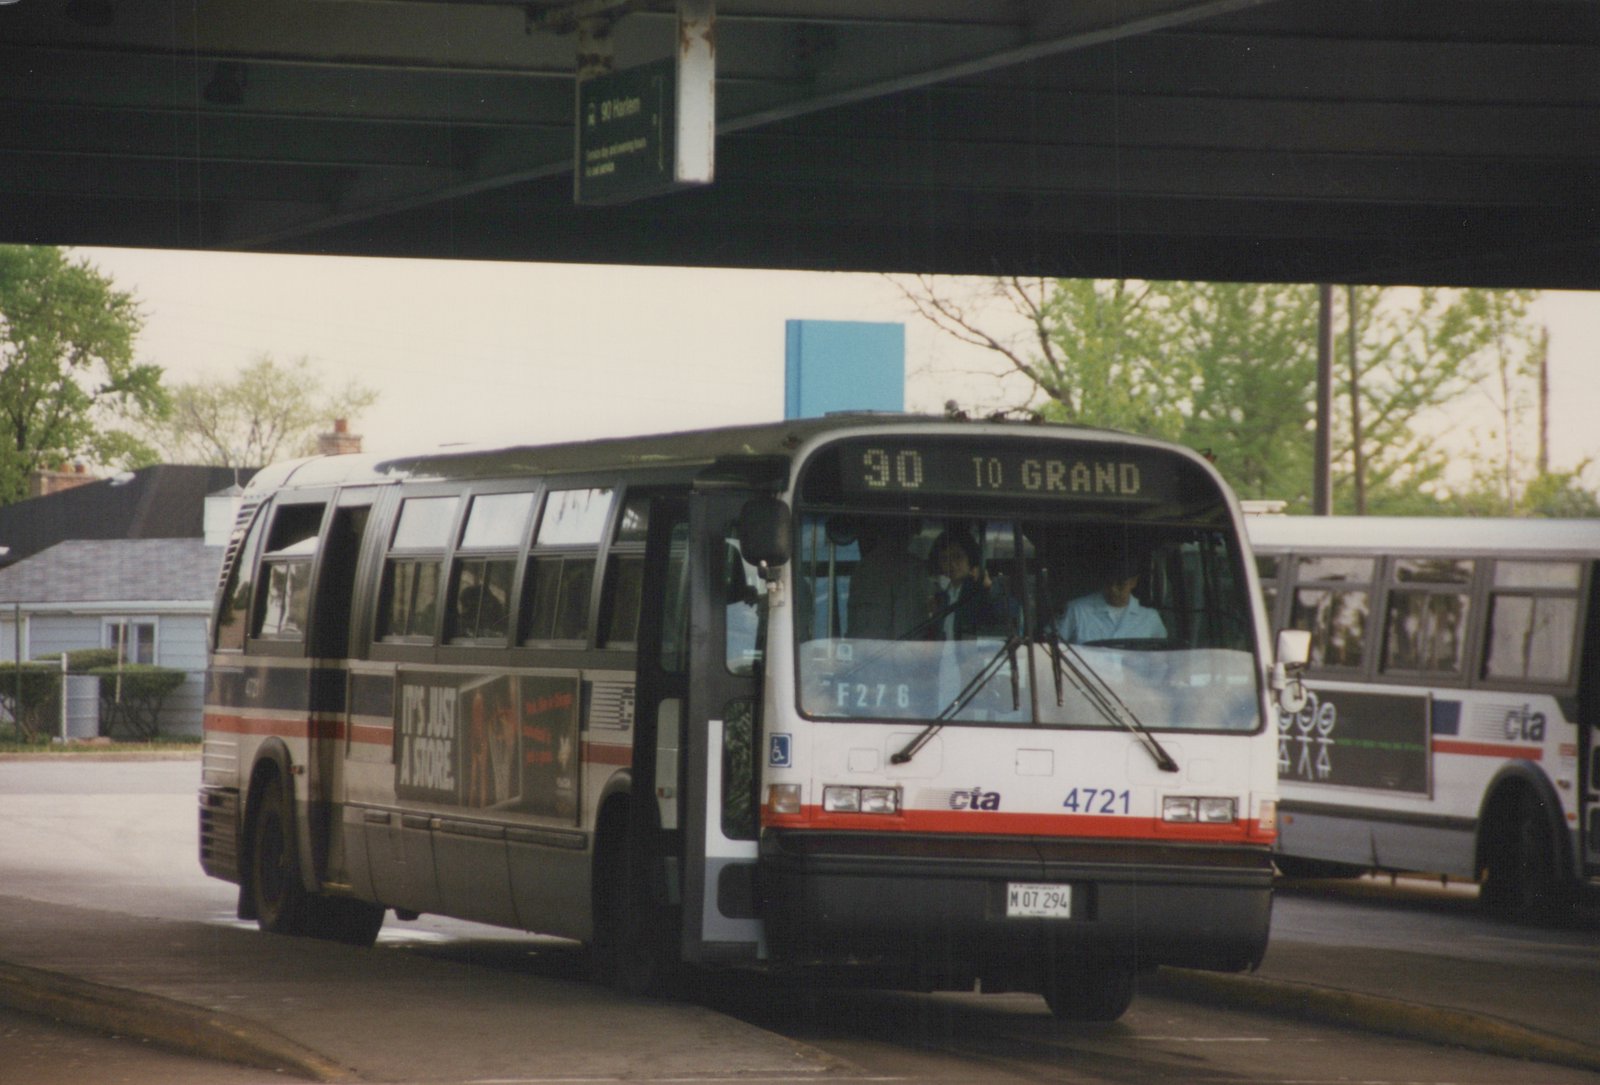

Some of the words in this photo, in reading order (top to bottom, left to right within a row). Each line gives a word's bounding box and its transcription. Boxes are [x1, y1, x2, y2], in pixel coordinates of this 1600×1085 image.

[864, 449, 923, 488] 90
[973, 457, 1002, 488] TO
[1021, 459, 1140, 494] GRAND
[427, 686, 456, 738] JUST
[1503, 703, 1546, 741] cta
[400, 735, 410, 784] A
[950, 787, 1000, 811] cta
[1063, 788, 1130, 814] 4721
[1023, 891, 1038, 907] 07
[1043, 892, 1067, 909] 294
